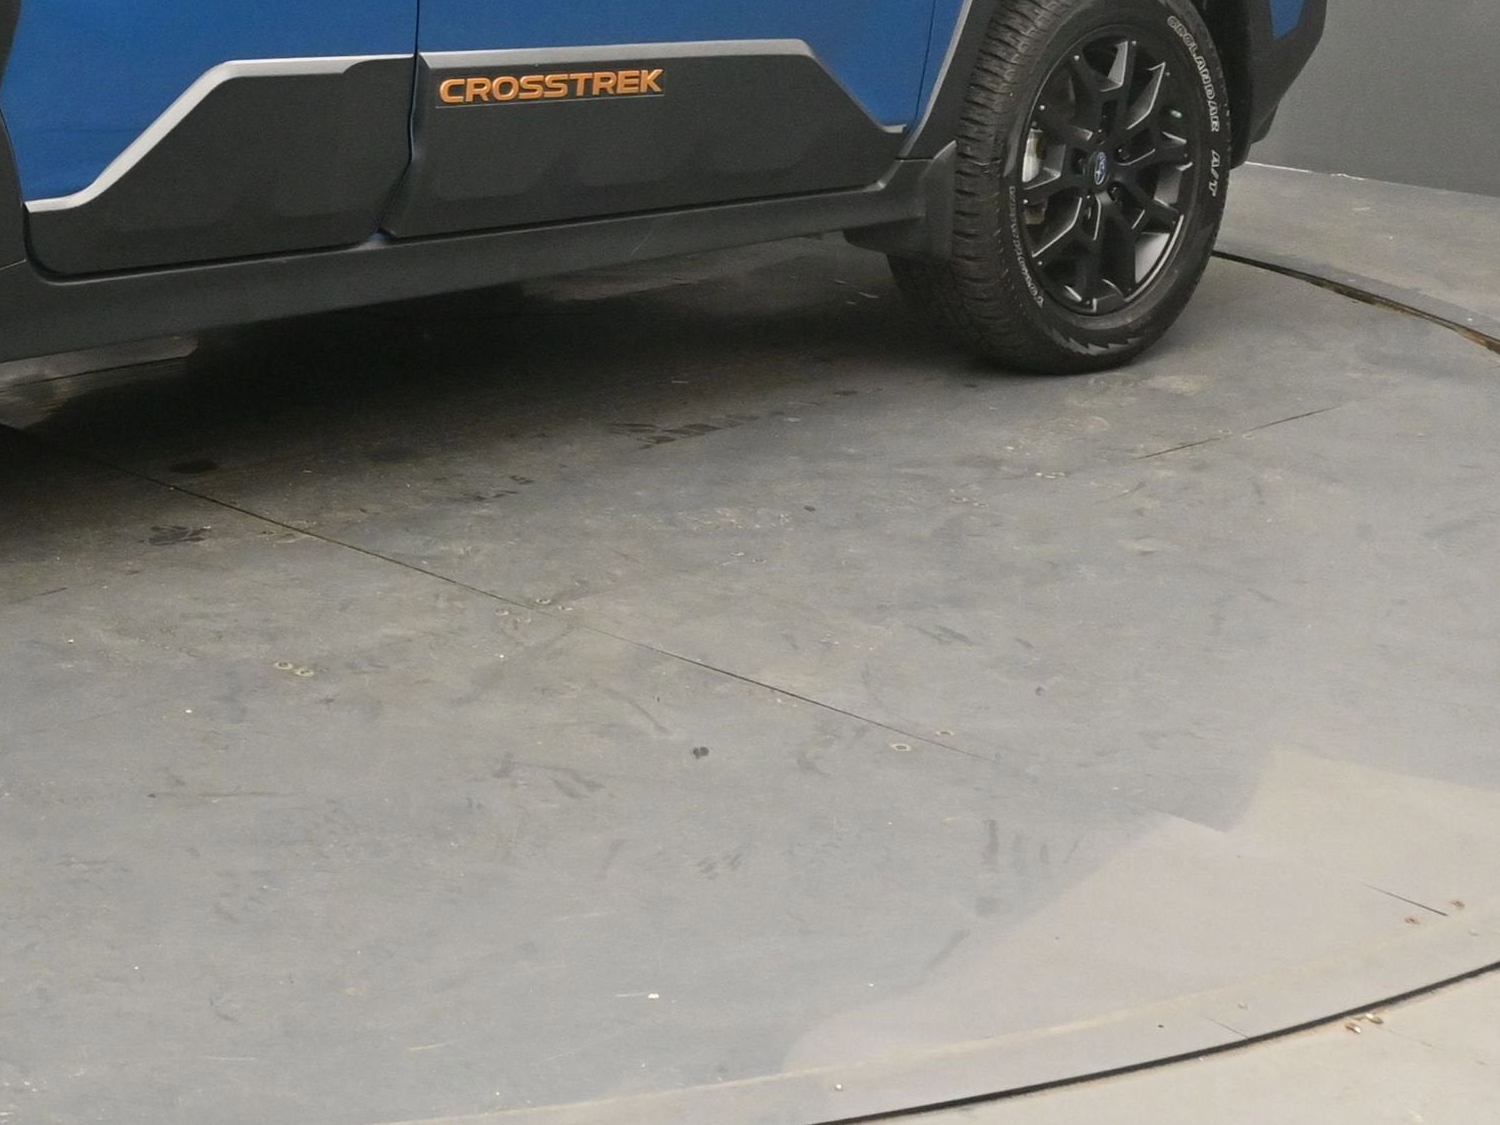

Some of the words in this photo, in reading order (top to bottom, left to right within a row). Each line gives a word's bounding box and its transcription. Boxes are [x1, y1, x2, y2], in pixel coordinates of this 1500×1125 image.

[438, 68, 664, 104] CROSSTREK
[1167, 15, 1220, 132] GEOLANDAR
[1208, 149, 1221, 197] A/T
